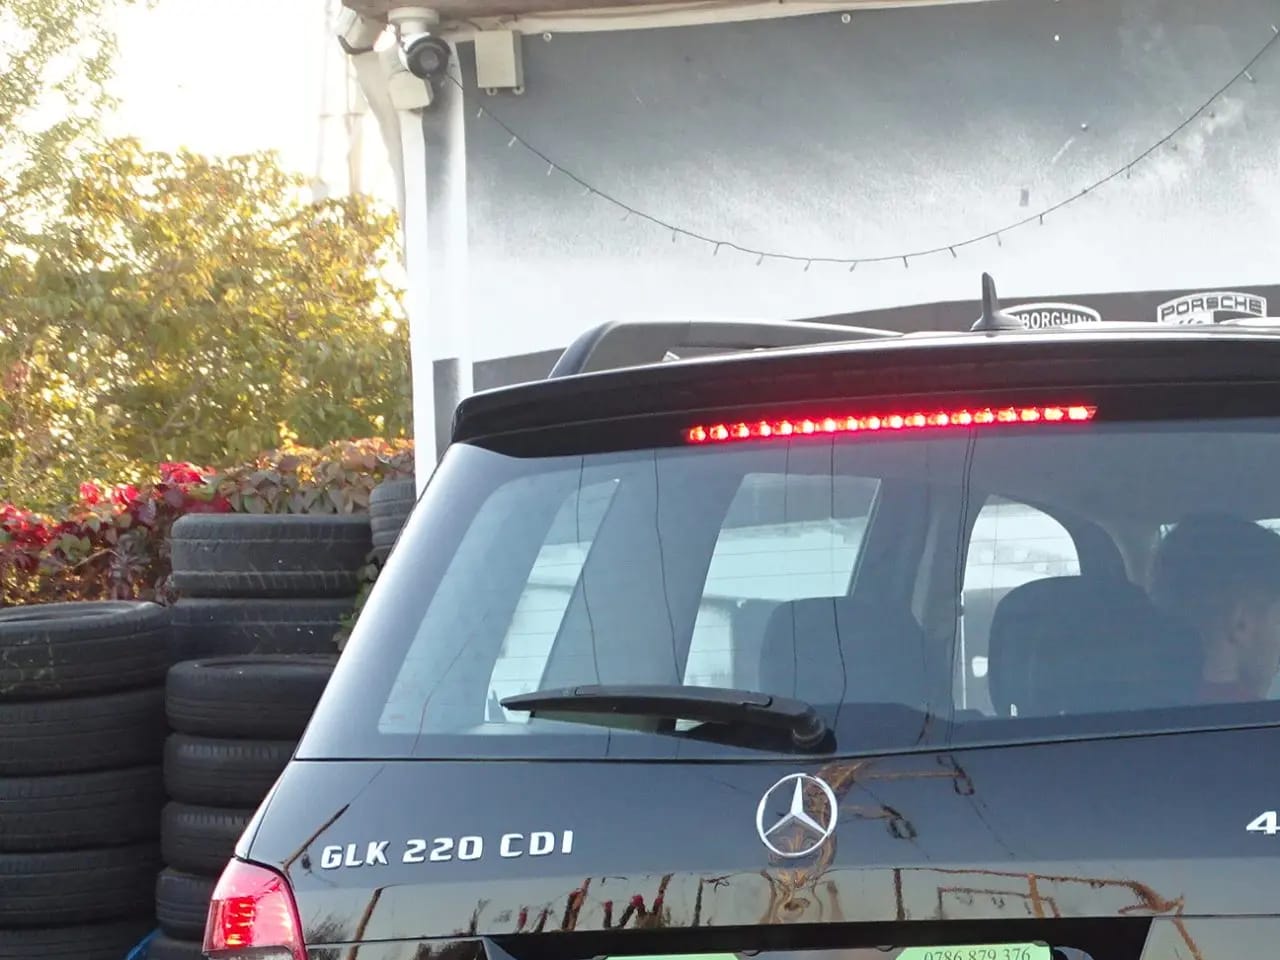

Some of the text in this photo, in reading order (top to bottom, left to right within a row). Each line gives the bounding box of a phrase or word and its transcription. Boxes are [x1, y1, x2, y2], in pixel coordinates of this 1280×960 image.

[1161, 296, 1263, 321] PORSCHE
[320, 830, 574, 869] GLK 220 CDI
